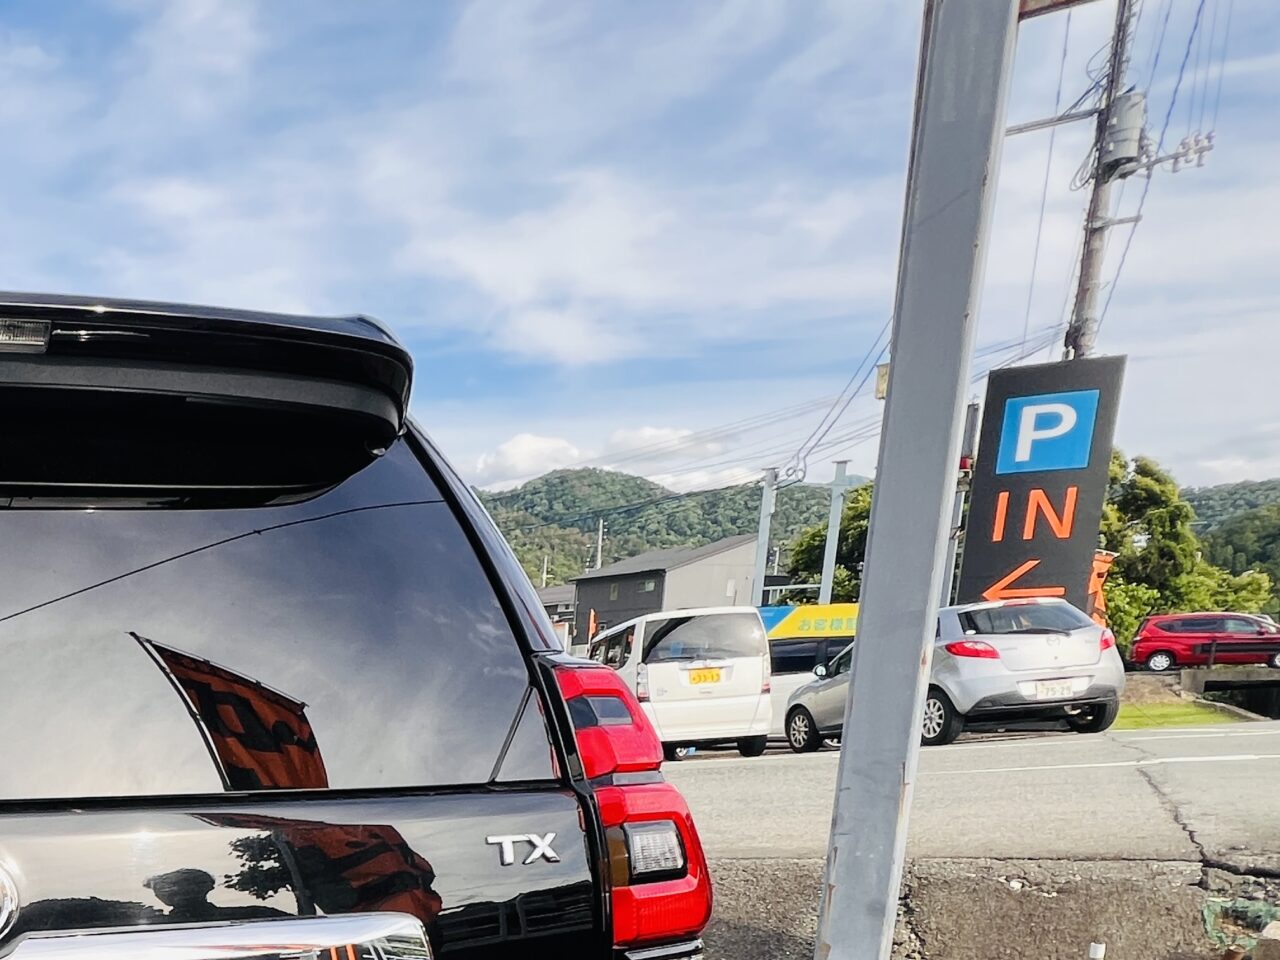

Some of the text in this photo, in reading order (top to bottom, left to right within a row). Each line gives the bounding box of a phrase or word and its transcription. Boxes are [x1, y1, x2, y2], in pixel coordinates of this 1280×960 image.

[1015, 403, 1077, 463] P
[992, 486, 1078, 542] IN
[485, 832, 561, 866] TX
